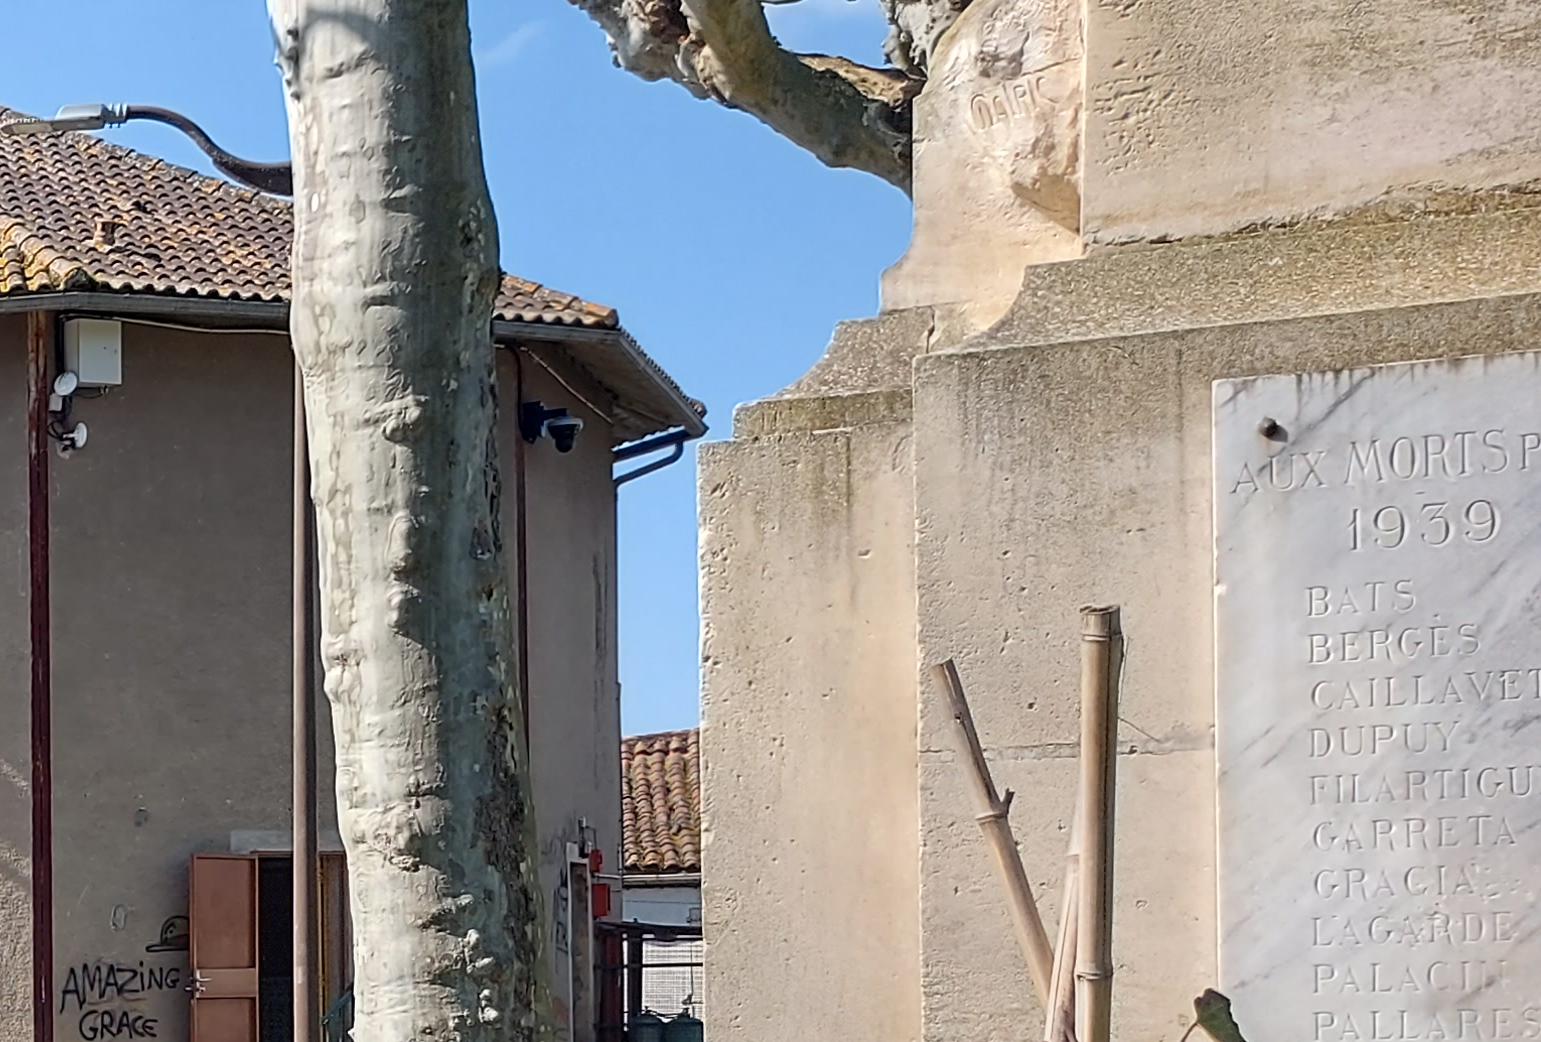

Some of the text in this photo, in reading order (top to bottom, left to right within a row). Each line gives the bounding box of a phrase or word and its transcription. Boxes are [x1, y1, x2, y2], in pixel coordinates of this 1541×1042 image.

[1229, 450, 1328, 494] AUX
[1343, 428, 1509, 485] MORTS
[1346, 499, 1499, 551] 1939
[1306, 578, 1417, 618] BATS
[1311, 668, 1541, 710] CAILLAVET
[1309, 720, 1461, 758] DUPUY
[1310, 765, 1541, 806] FILARTIGU
[1313, 814, 1517, 852] GARRETA
[1313, 865, 1476, 901] GRACIA
[1312, 911, 1519, 948] LAGARDE
[79, 1009, 159, 1041] GRACE
[1312, 1007, 1541, 1042] PALLARES
